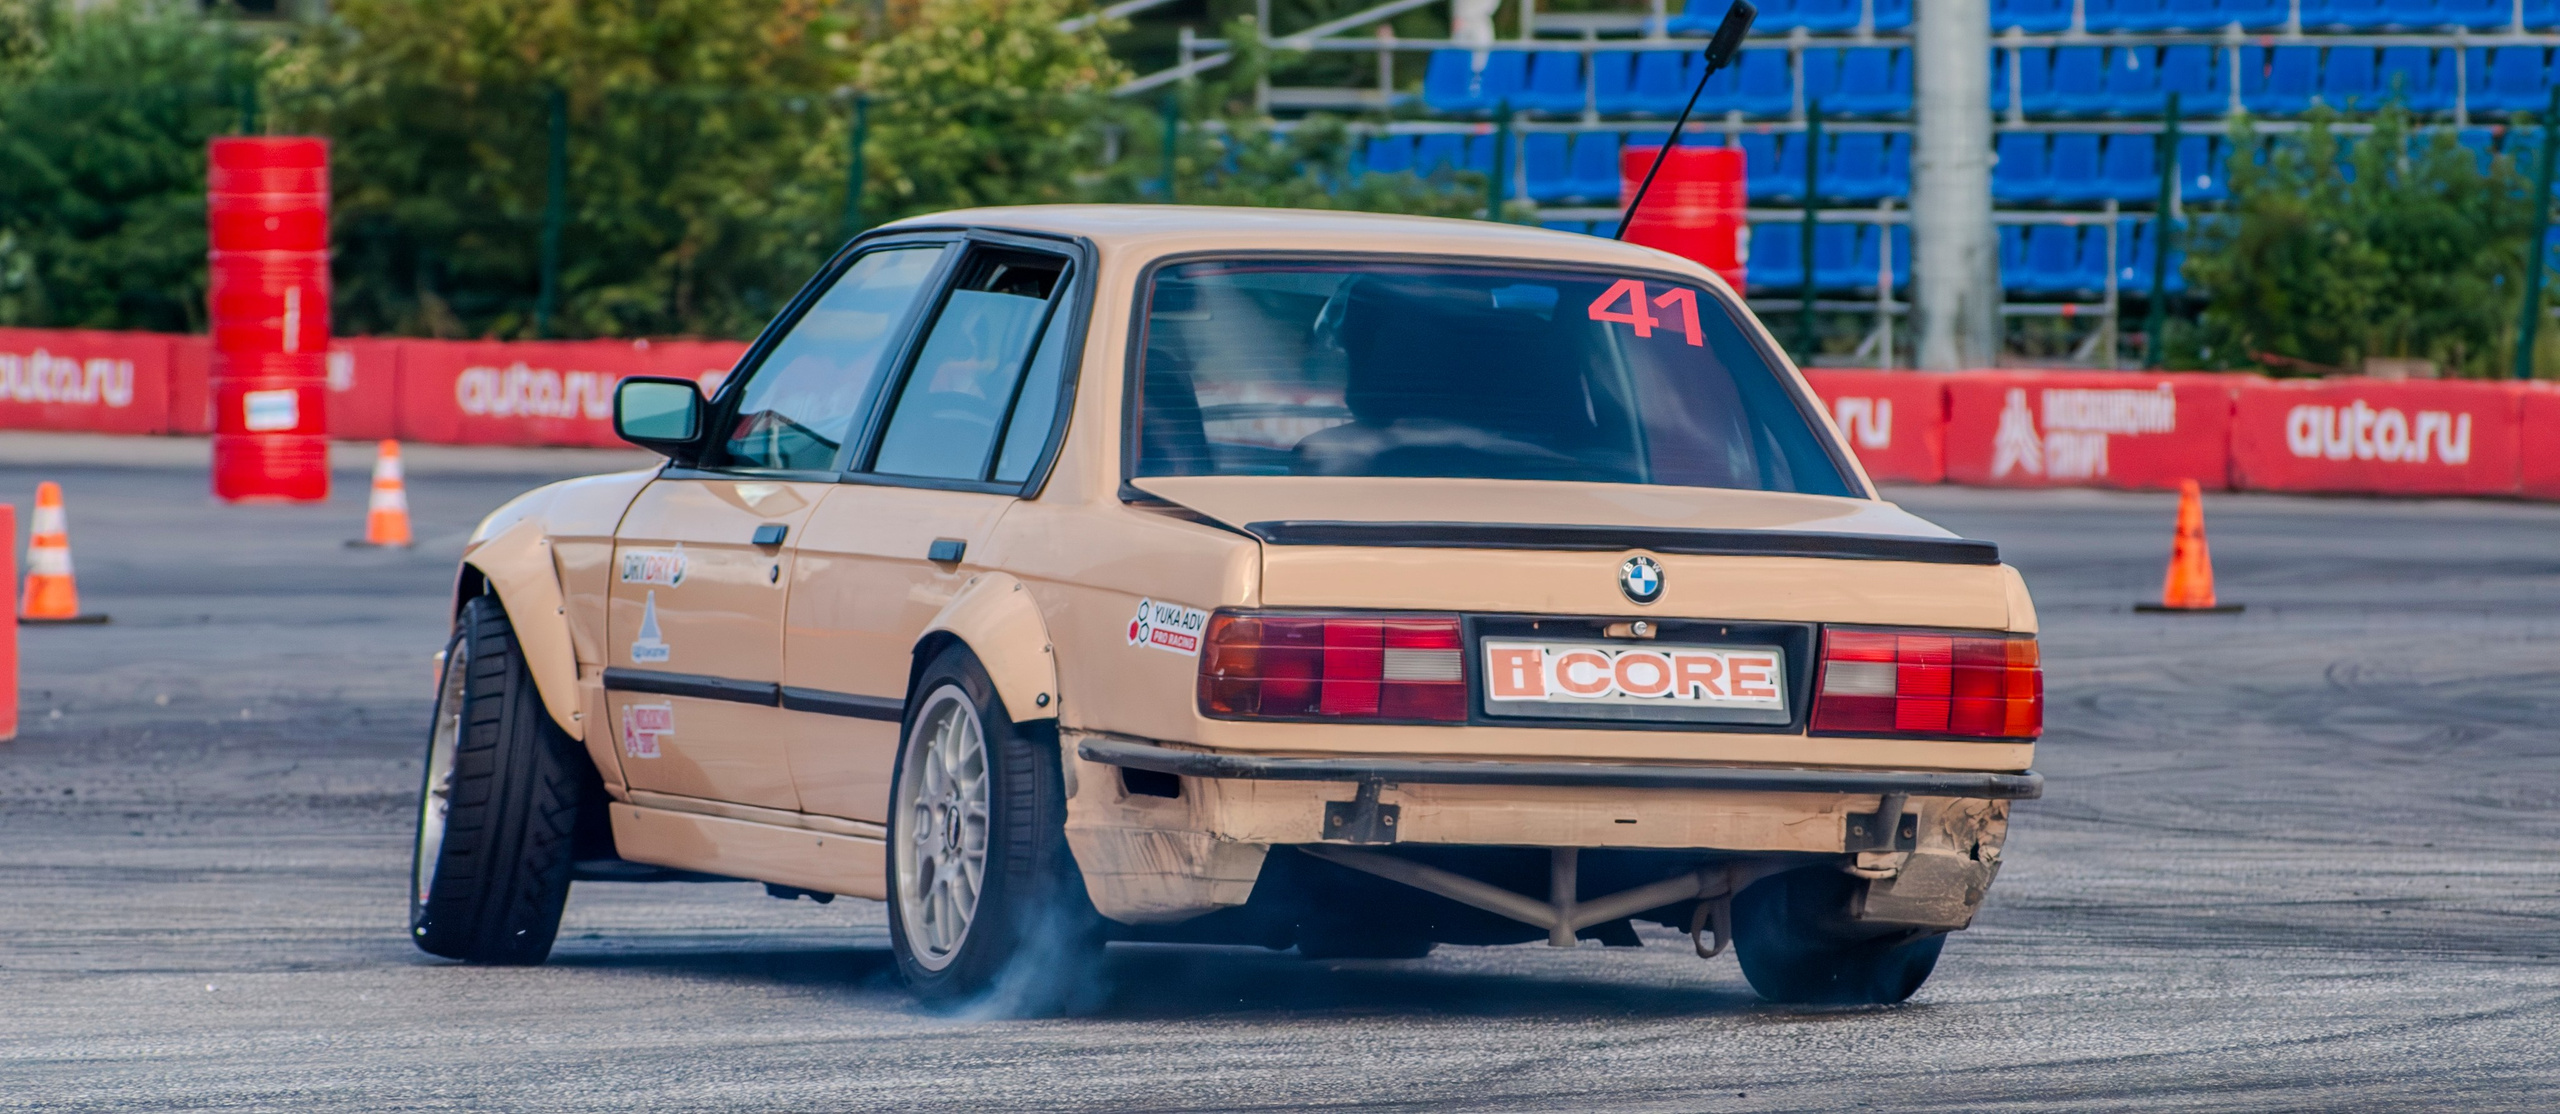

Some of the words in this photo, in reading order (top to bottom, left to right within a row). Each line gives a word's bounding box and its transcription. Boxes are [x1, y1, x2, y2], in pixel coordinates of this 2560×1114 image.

[1587, 278, 1704, 347] 41
[2286, 399, 2472, 465] auto.ru
[1623, 556, 1663, 573] BMW
[1154, 605, 1181, 628] YUKA
[1181, 611, 1205, 632] ADV
